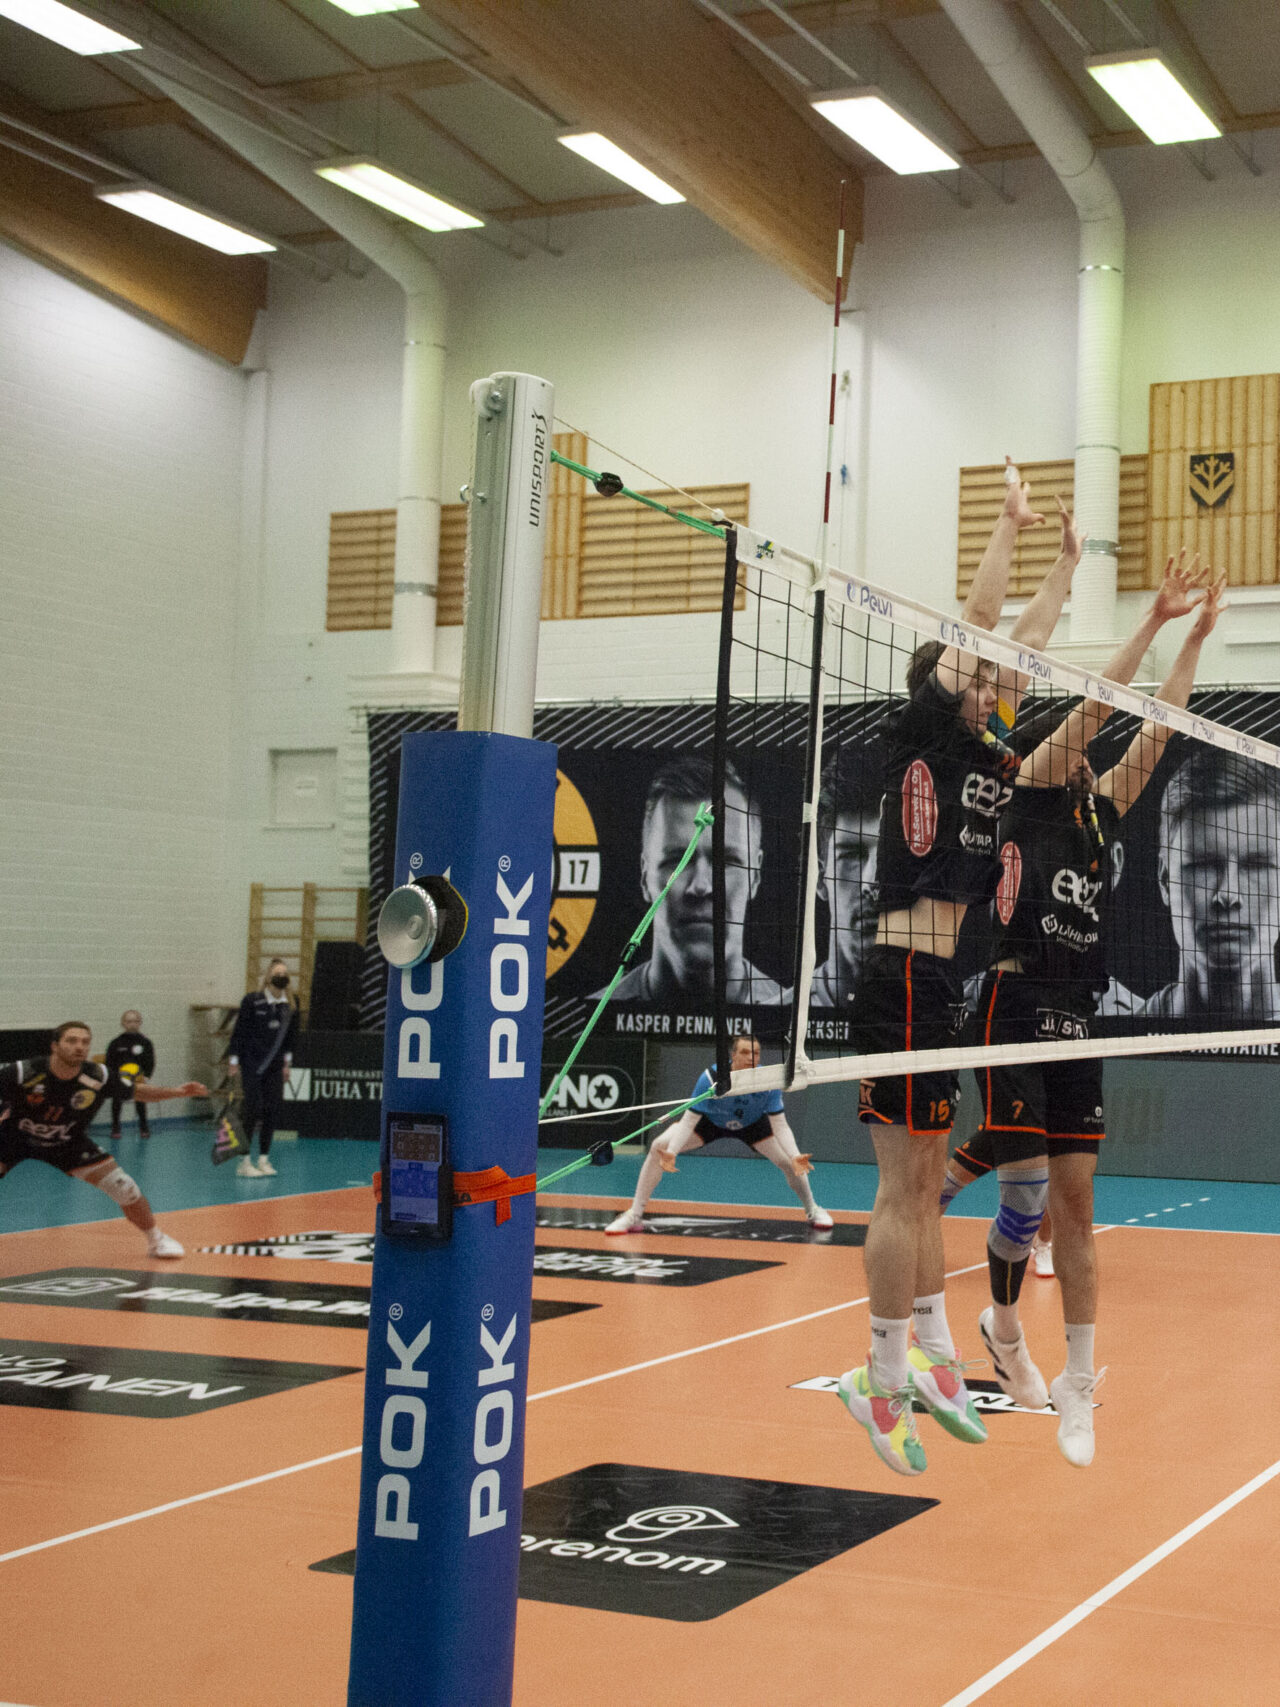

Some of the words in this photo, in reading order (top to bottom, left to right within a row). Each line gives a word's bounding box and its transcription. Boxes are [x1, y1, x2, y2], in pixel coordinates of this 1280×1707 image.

[569, 860, 590, 885] 17
[616, 1013, 670, 1033] KASPER
[677, 1015, 752, 1036] PENNNEN
[312, 1081, 362, 1100] JUHA
[929, 1099, 950, 1122] 15
[1012, 1101, 1024, 1120] 7
[0, 1370, 246, 1400] AINEN
